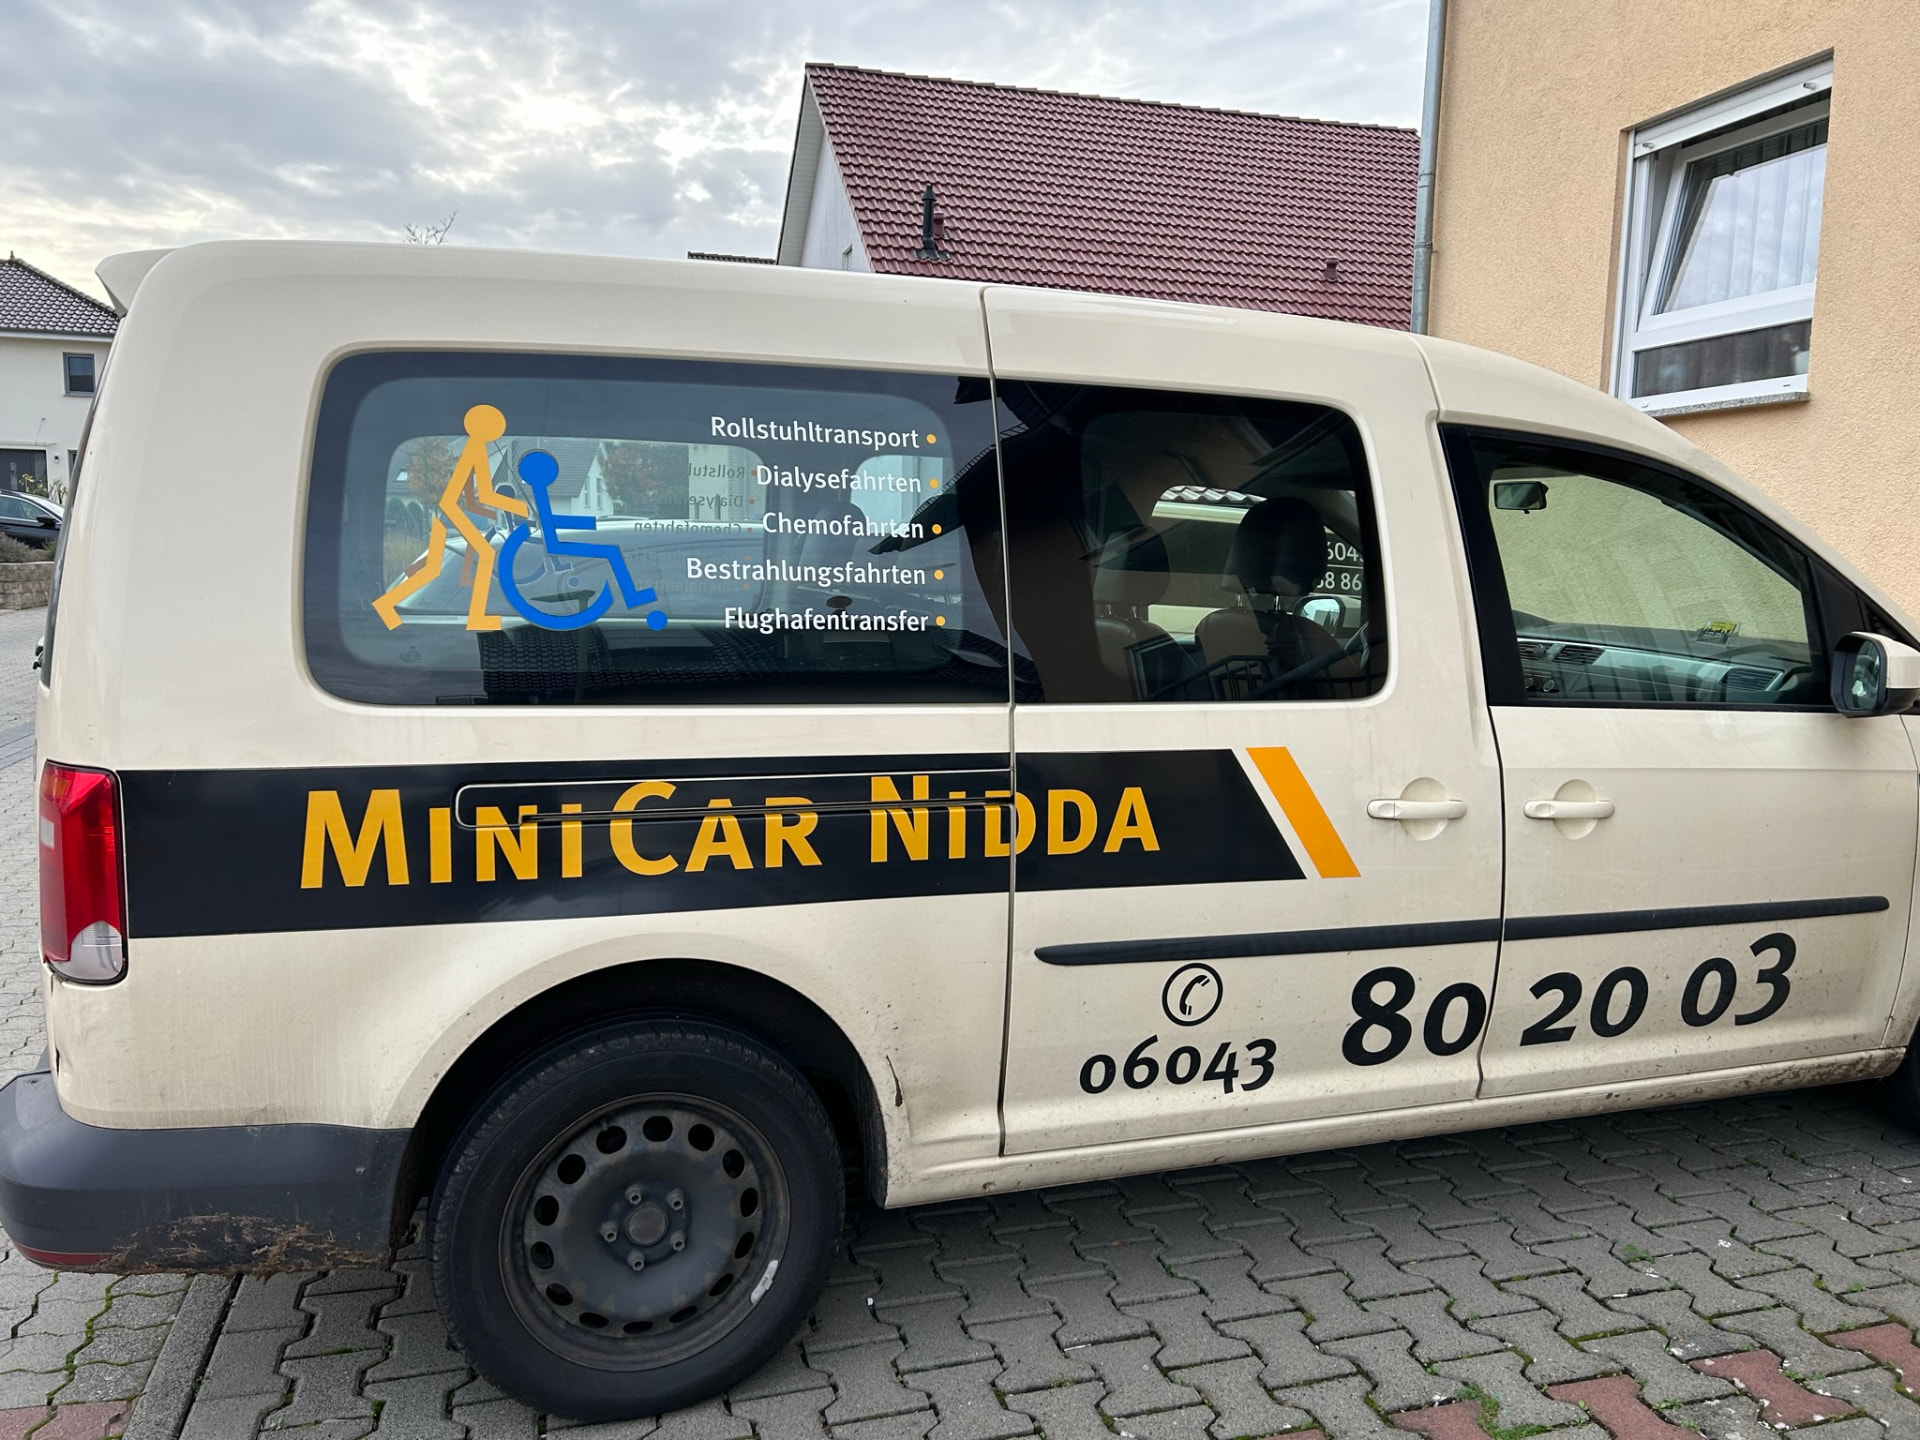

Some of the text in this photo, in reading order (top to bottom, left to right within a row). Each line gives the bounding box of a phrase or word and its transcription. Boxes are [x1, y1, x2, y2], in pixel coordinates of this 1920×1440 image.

[711, 416, 919, 450] Rollstuhltransport
[756, 465, 922, 493] Dialysefahrten
[762, 512, 924, 539] Chemofahrten
[686, 557, 926, 587] Bestrahlungsfahrten
[1340, 572, 1362, 591] 86
[724, 607, 929, 634] Flughafentransfer
[1079, 932, 1797, 1094] 06043 80 20 03
